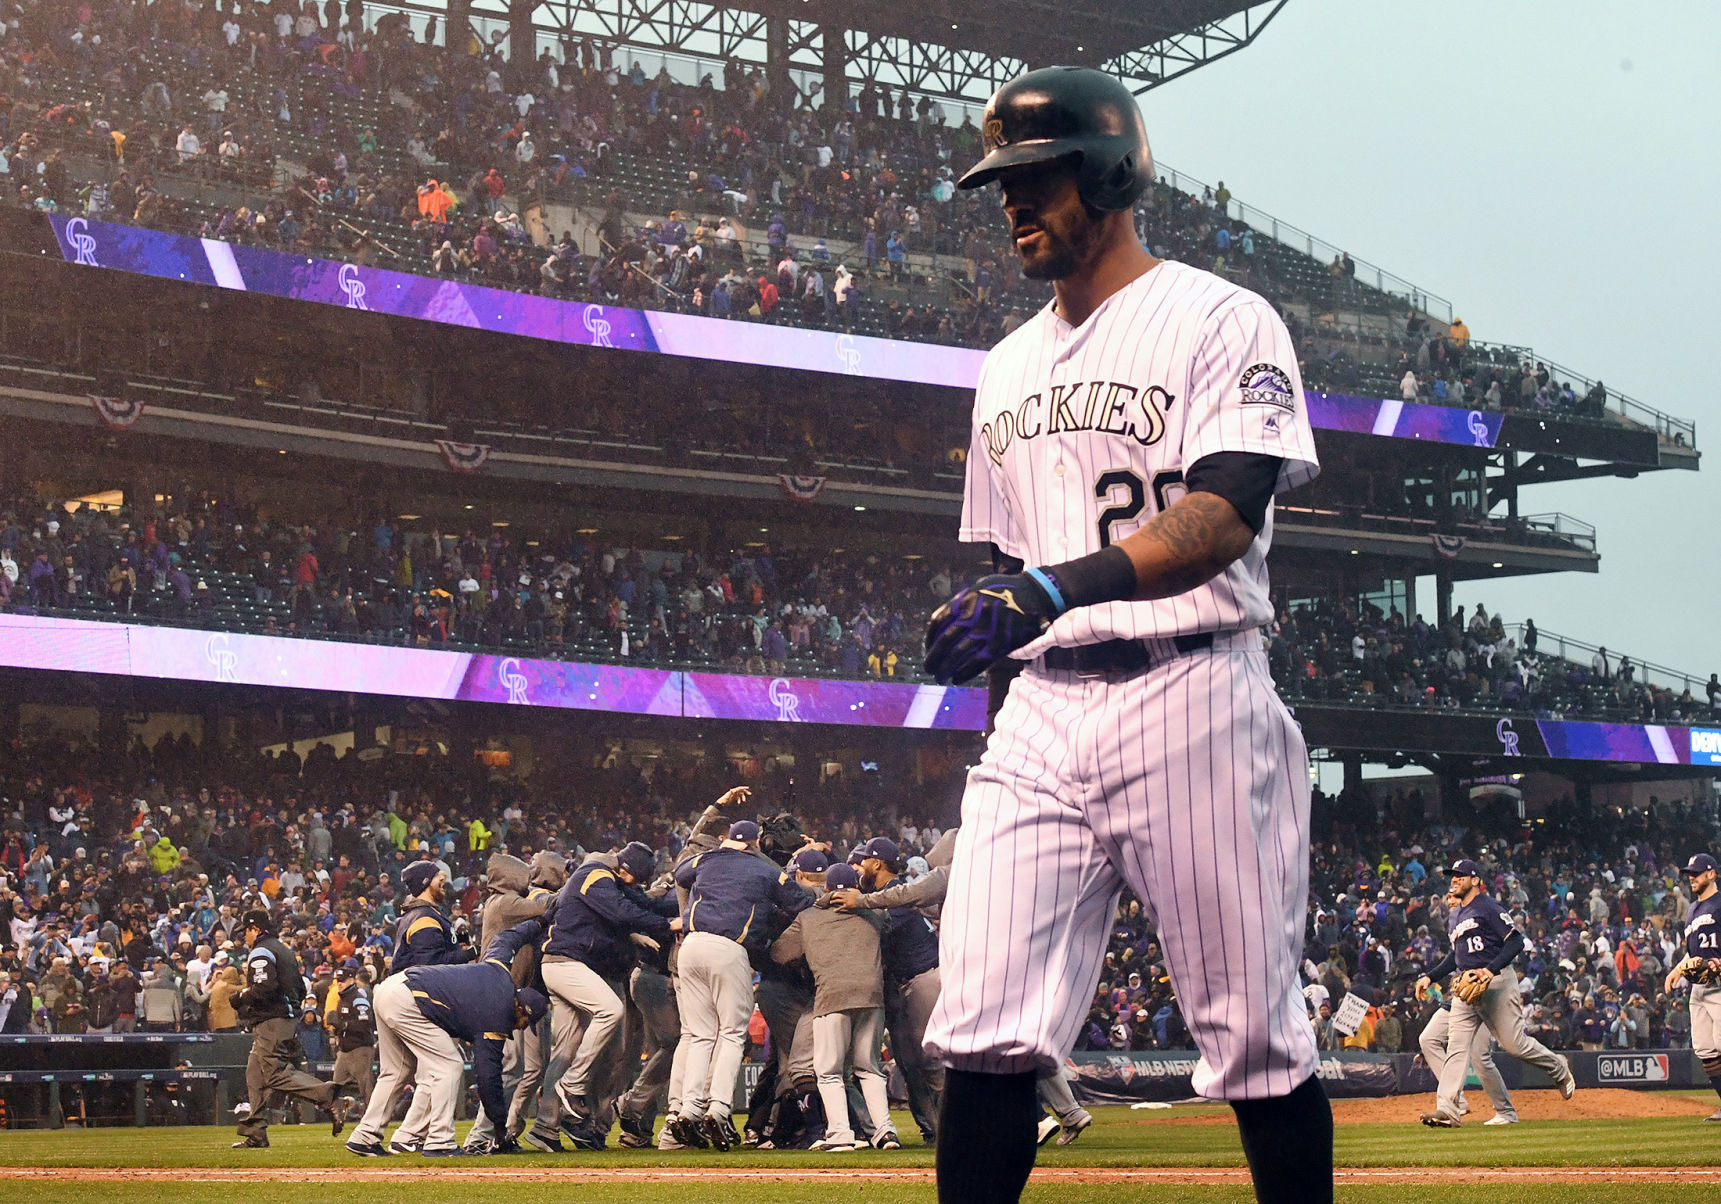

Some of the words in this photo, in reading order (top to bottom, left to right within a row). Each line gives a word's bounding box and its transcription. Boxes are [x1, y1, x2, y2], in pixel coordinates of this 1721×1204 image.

[1239, 363, 1293, 394] COLORADO
[1240, 388, 1294, 409] ROCKIES
[981, 381, 1175, 467] ROCKIES
[1466, 935, 1485, 953] 18
[1698, 932, 1719, 948] 21
[1134, 1060, 1164, 1076] MLB
[1601, 1059, 1644, 1077] @MLB
